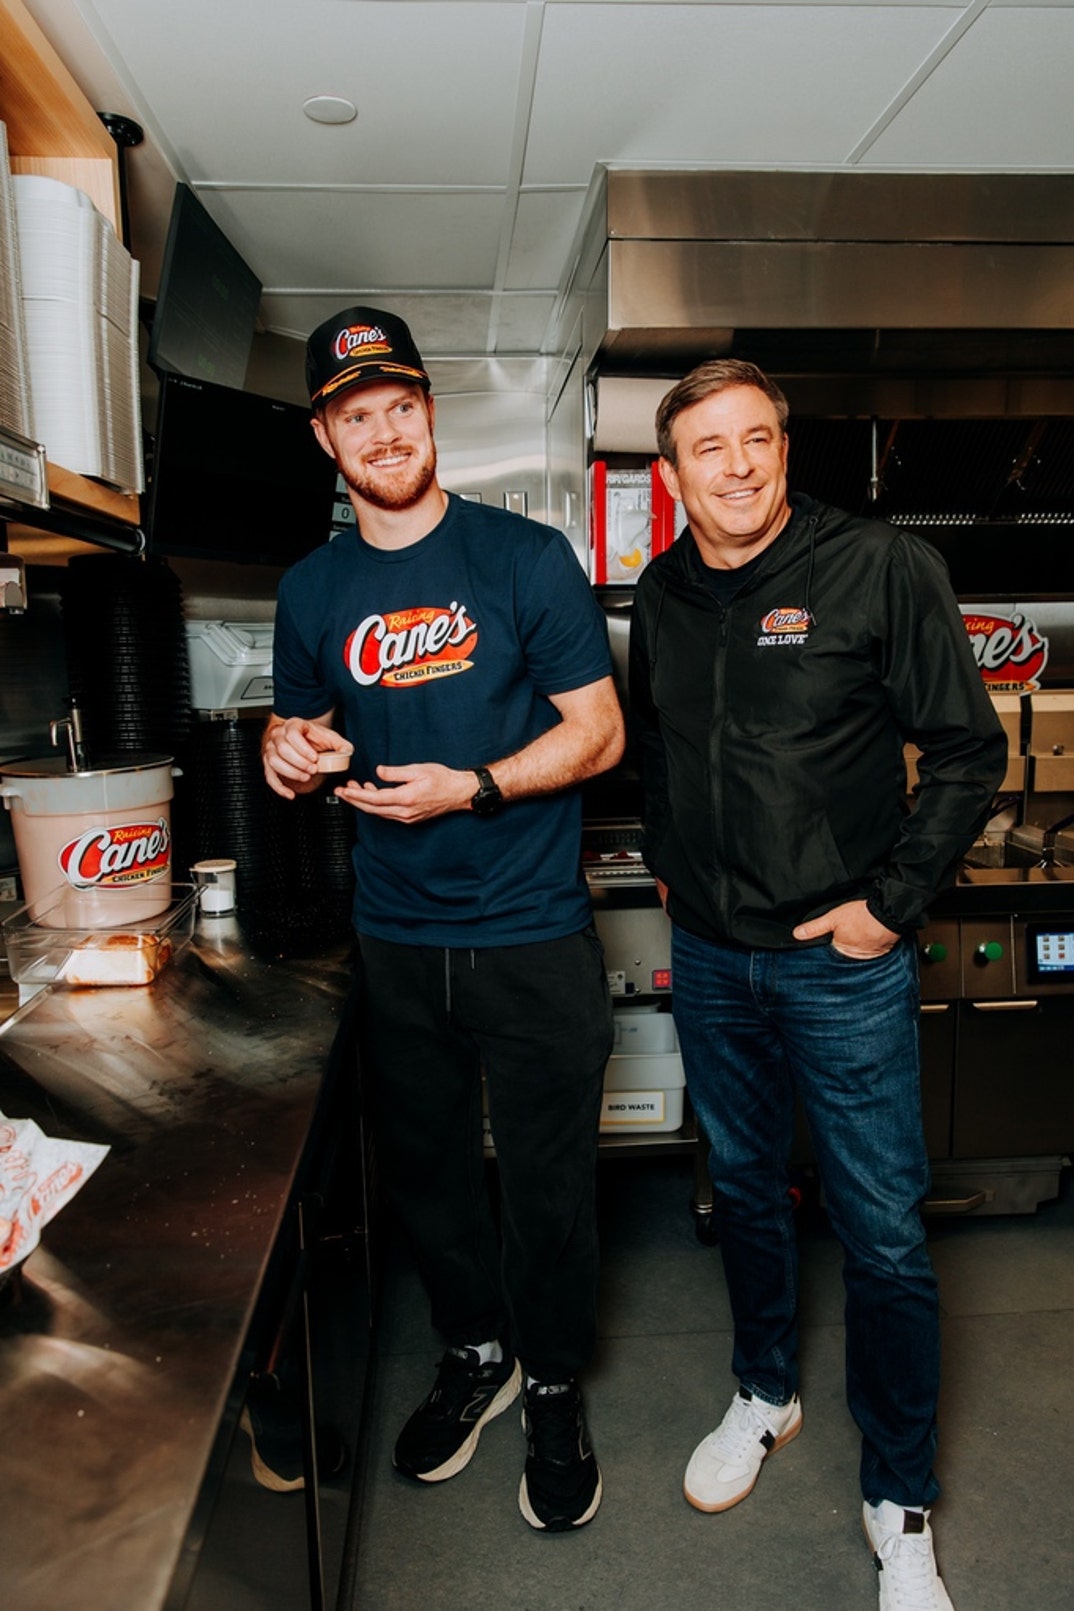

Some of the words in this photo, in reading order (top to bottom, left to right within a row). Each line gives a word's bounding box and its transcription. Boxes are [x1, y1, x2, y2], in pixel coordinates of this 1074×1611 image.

[336, 326, 386, 359] Cane's
[389, 610, 435, 630] Raising
[762, 607, 810, 633] Cane's
[349, 601, 477, 686] Cane's
[757, 635, 776, 646] ONE
[968, 613, 1043, 669] ne's
[113, 827, 152, 843] Raising
[67, 818, 169, 885] Cane's
